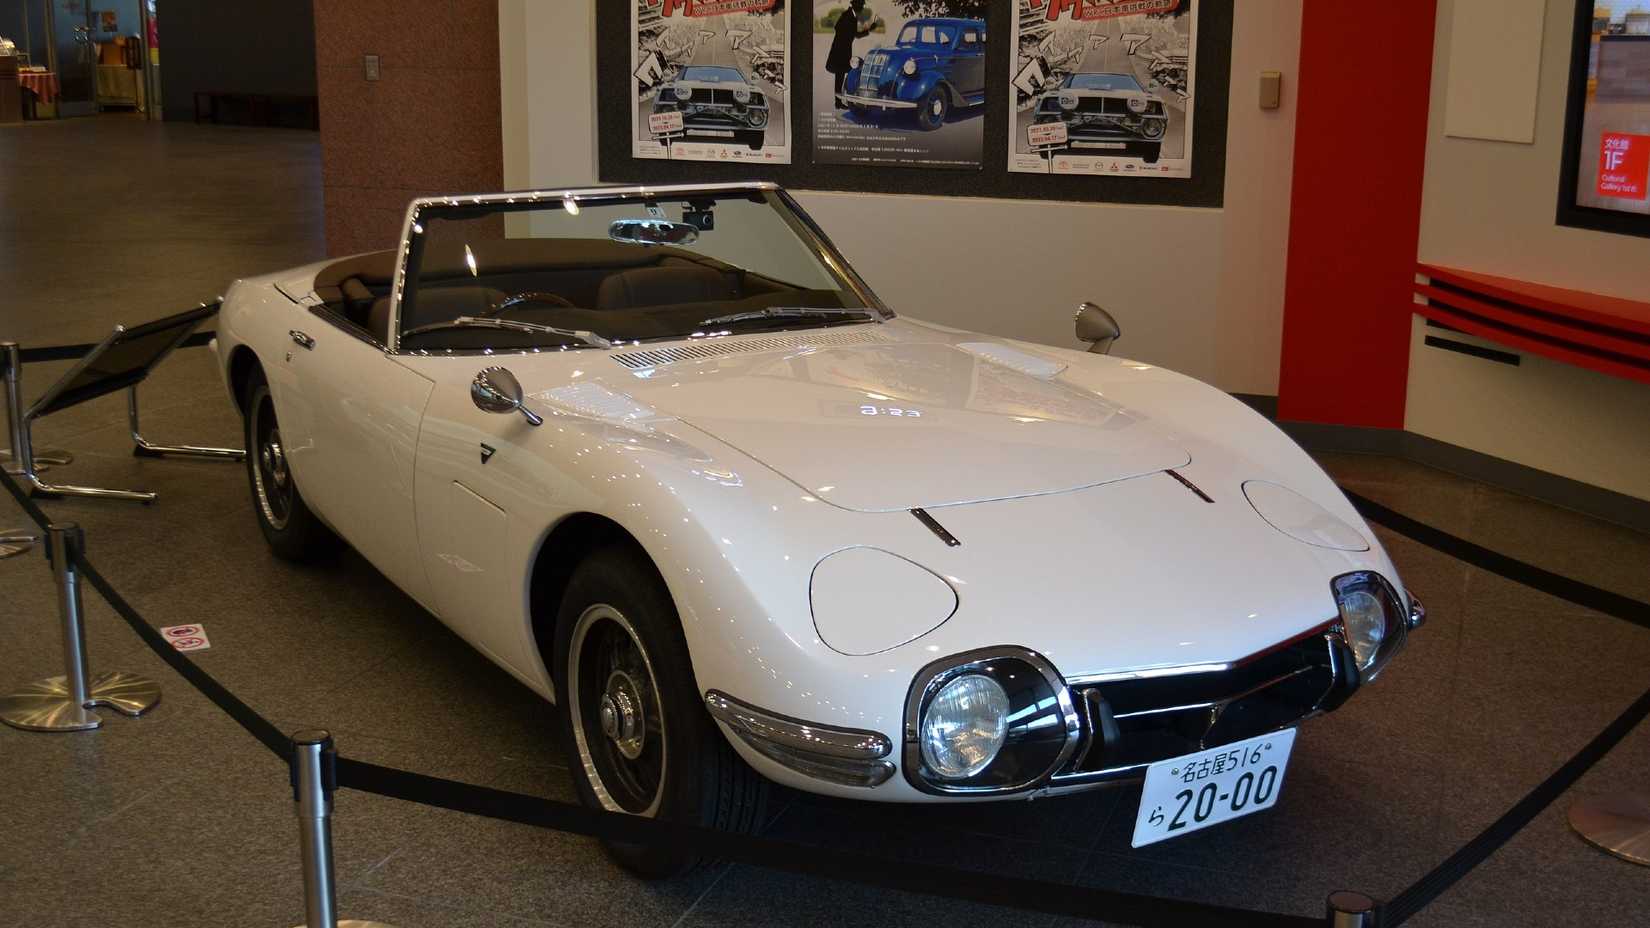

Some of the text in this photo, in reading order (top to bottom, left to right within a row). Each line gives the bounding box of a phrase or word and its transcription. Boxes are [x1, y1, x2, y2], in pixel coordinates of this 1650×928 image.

[1604, 151, 1624, 170] 1F
[1148, 765, 1277, 831] ら 20-00
